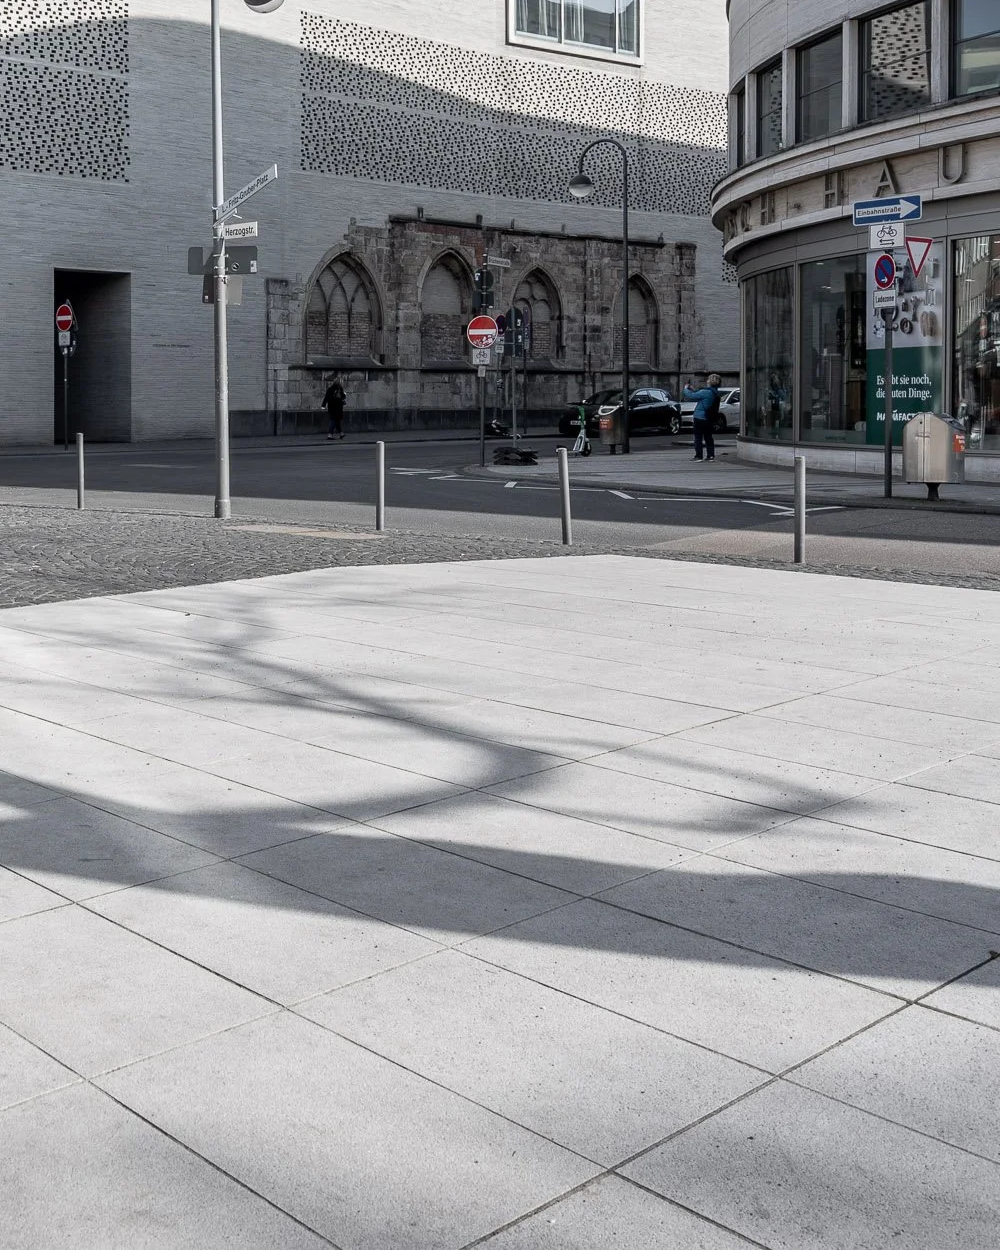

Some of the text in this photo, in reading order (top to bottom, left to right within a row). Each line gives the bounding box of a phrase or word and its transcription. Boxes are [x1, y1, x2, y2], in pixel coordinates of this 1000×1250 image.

[857, 206, 902, 216] Einbahnstraße
[225, 225, 255, 236] Herzogstr.
[875, 295, 894, 303] Ladezone
[876, 374, 885, 385] Es
[900, 374, 910, 385] sie
[911, 373, 932, 386] noch,
[891, 389, 907, 398] uten
[908, 387, 932, 401] Dinge.
